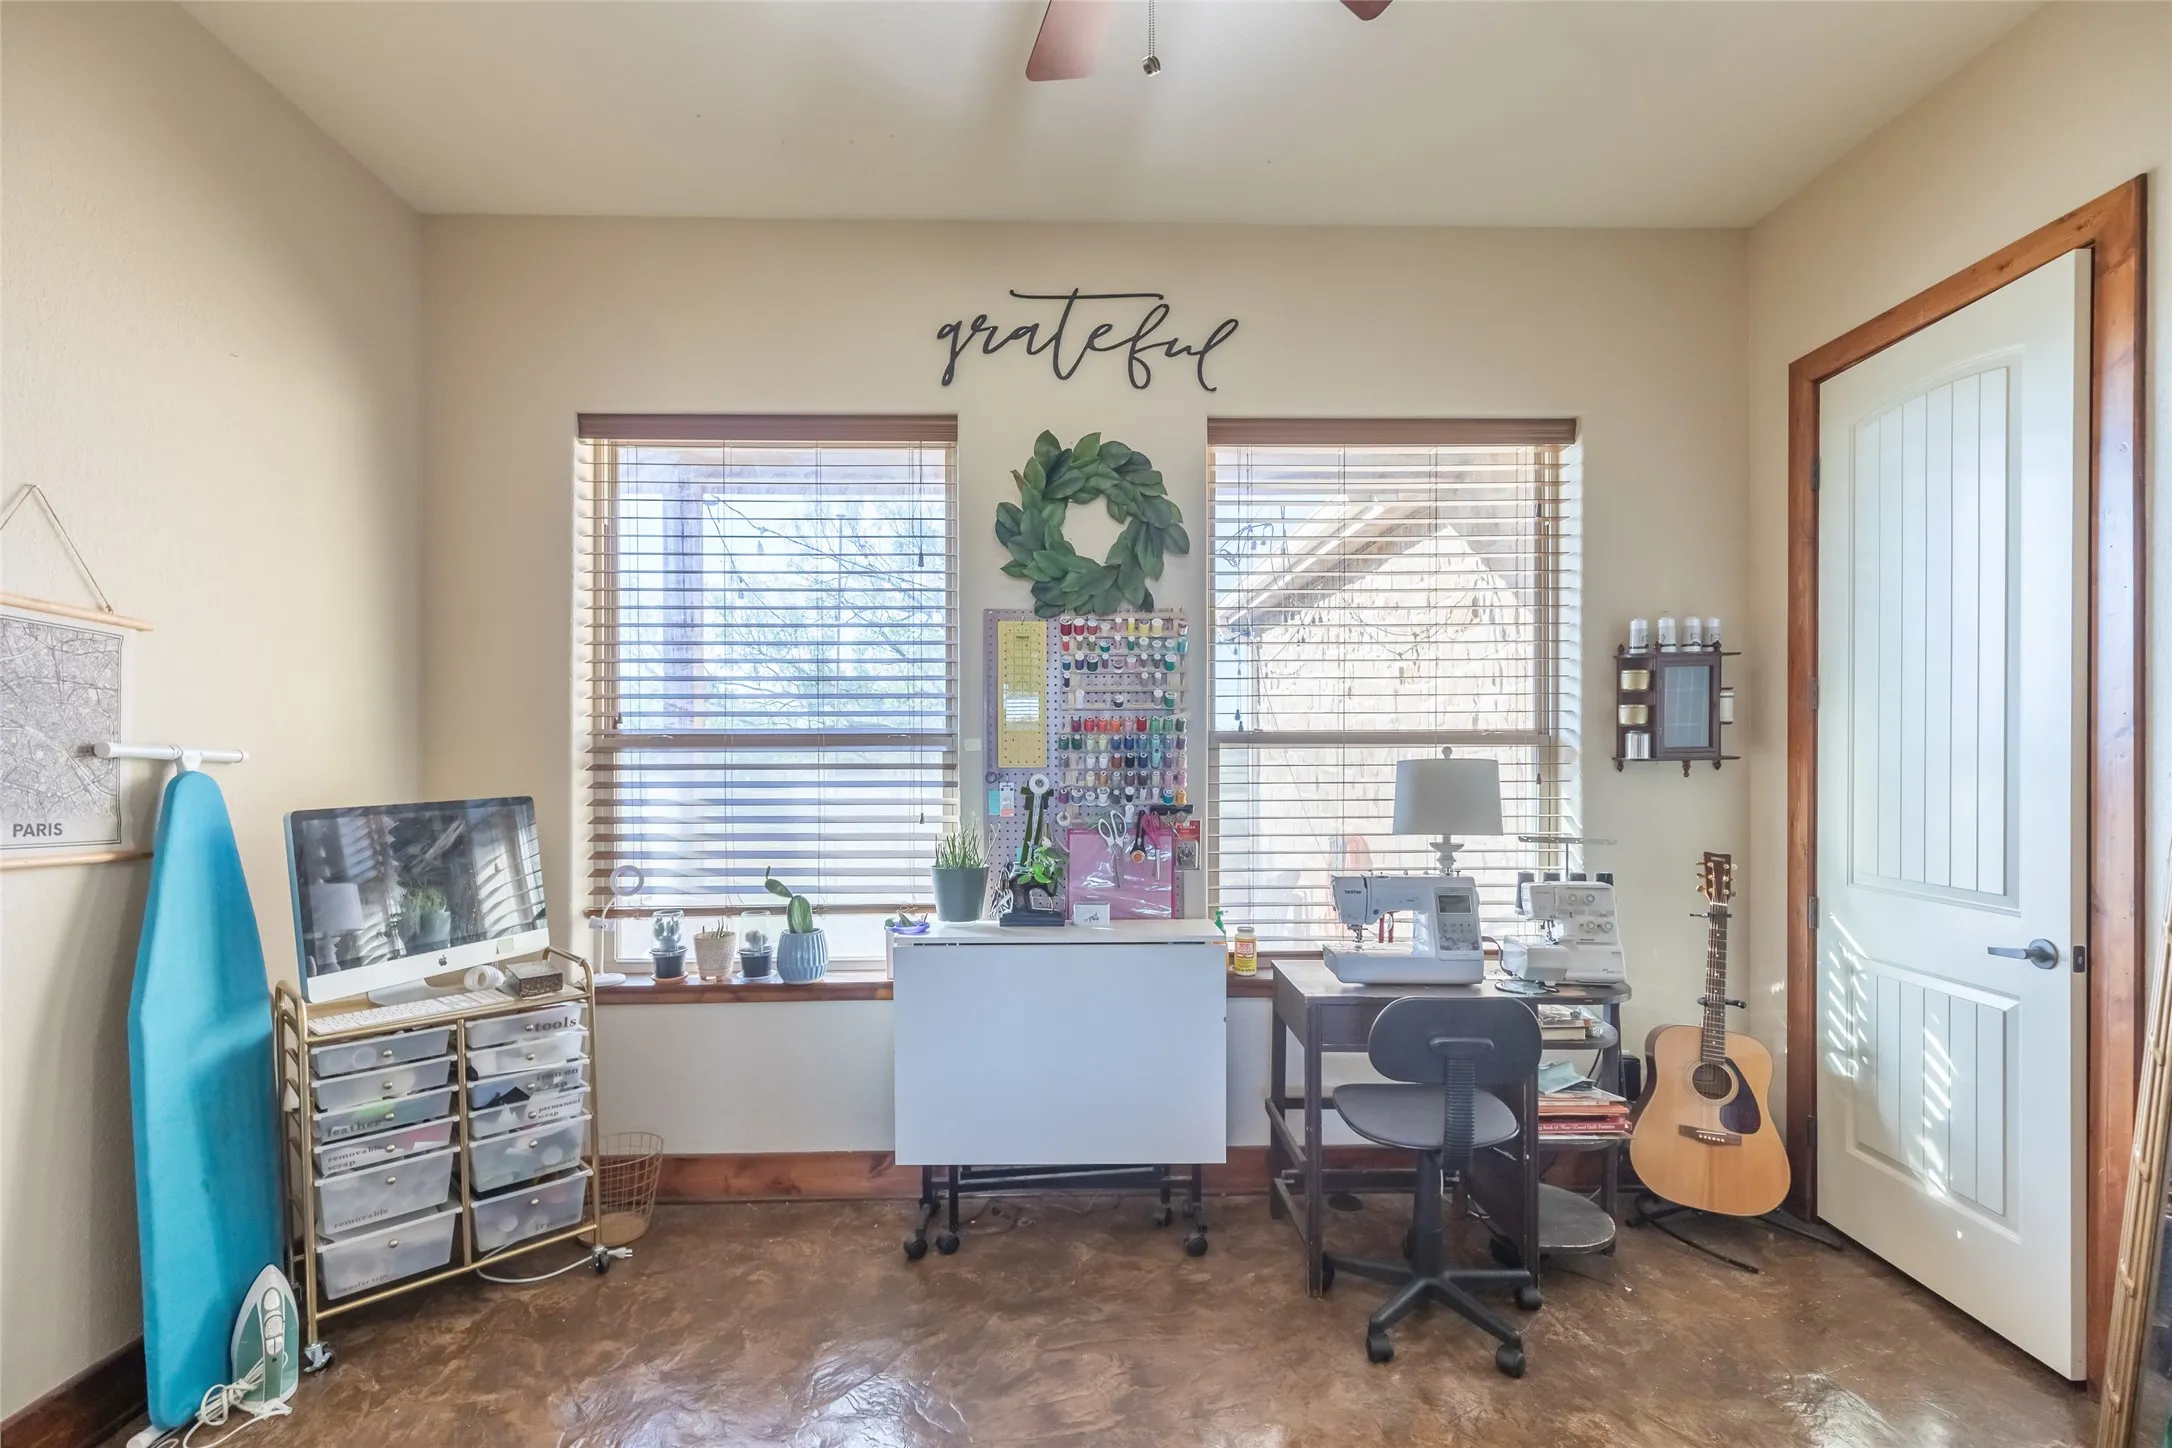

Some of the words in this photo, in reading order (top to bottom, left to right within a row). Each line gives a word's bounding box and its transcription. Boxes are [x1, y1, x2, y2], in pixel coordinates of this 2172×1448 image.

[936, 287, 1239, 392] grateful
[12, 822, 63, 838] PARIS
[535, 1016, 577, 1032] tools
[564, 1068, 578, 1076] on
[538, 1099, 580, 1113] permanent
[538, 1111, 559, 1119] scrap
[327, 1120, 382, 1138] leather
[327, 1145, 387, 1163] removable
[327, 1159, 356, 1171] scrap
[334, 1208, 389, 1229] removable
[371, 1275, 389, 1283] tap
